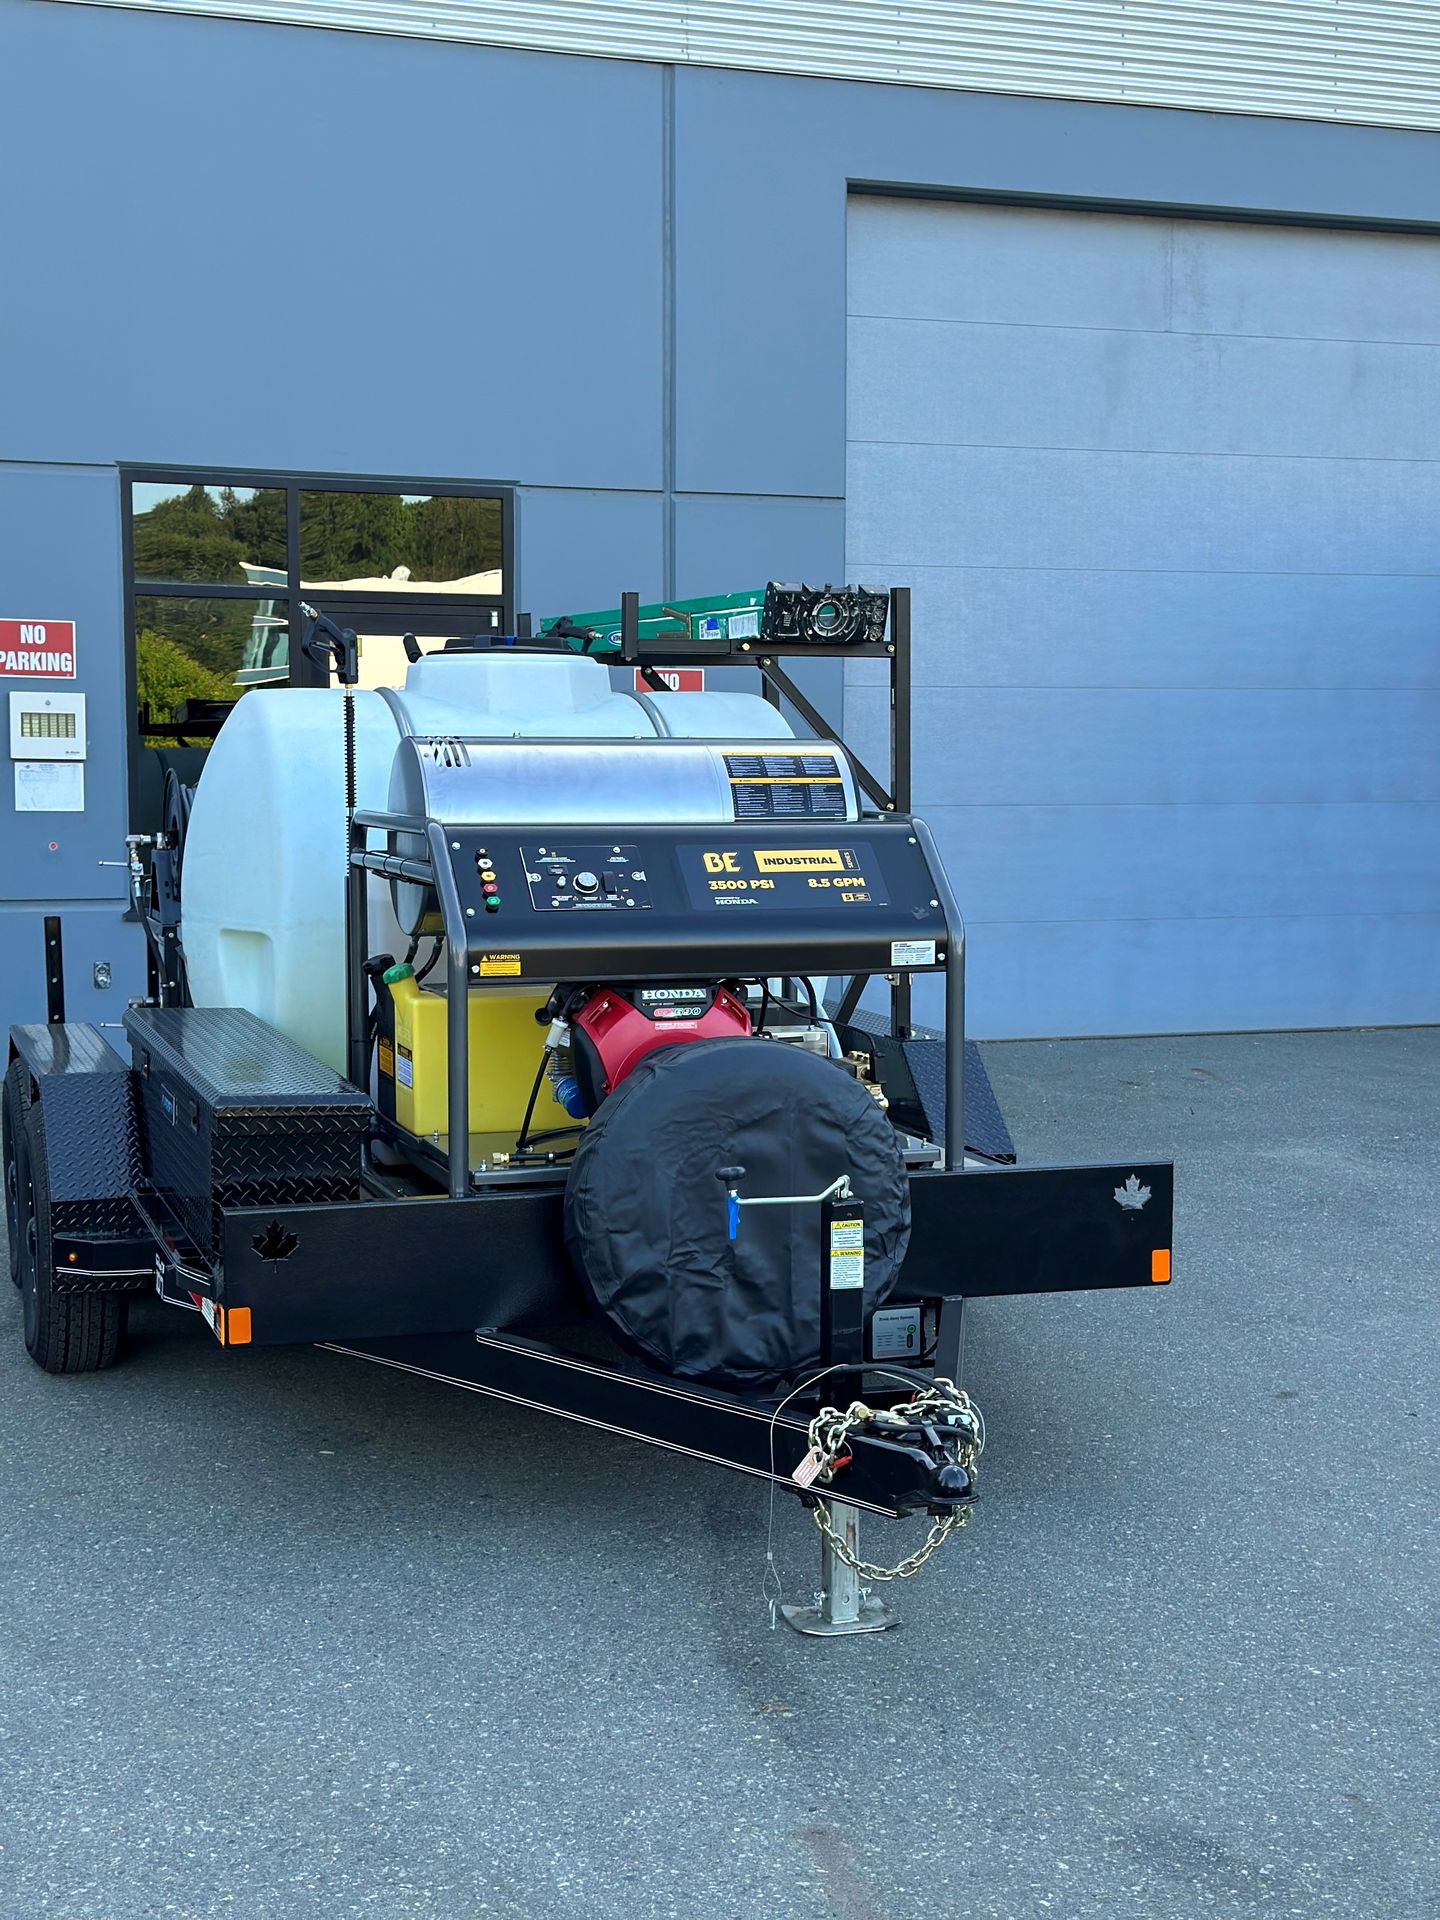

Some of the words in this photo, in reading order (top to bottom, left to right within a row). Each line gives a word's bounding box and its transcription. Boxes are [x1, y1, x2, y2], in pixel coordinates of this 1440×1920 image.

[20, 624, 46, 645] NO
[703, 852, 741, 872] BE
[763, 857, 838, 865] INDUSTRIAL
[708, 879, 748, 890] 3500
[750, 879, 775, 889] PSI
[807, 878, 831, 888] 8.5
[832, 877, 866, 888] GPM
[641, 988, 707, 1000] HONDA
